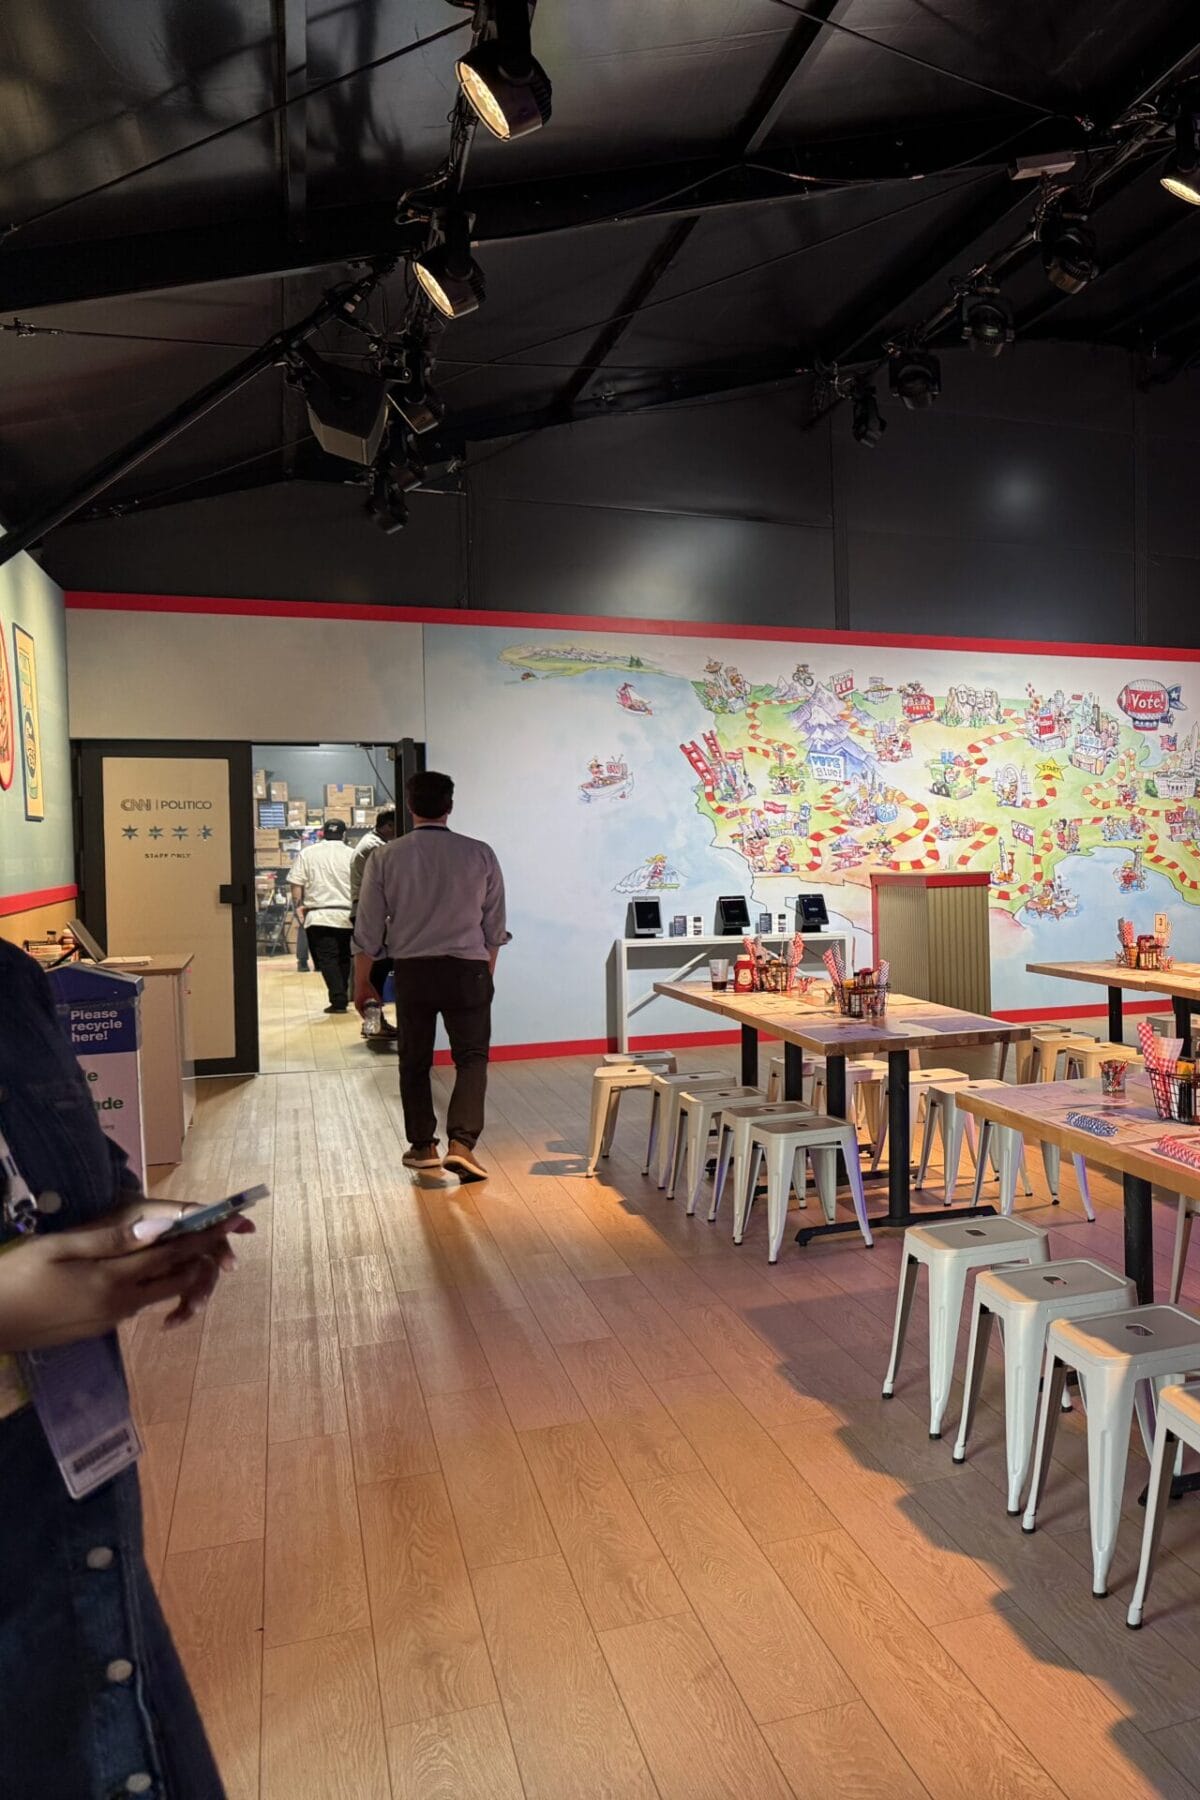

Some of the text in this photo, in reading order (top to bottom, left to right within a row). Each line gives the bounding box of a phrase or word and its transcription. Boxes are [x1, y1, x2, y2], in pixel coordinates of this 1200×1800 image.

[1130, 692, 1165, 710] Vote!
[120, 798, 213, 811] CNN POLITICO
[70, 1009, 119, 1021] Please
[71, 1019, 123, 1033] recycle
[71, 1030, 109, 1042] here!
